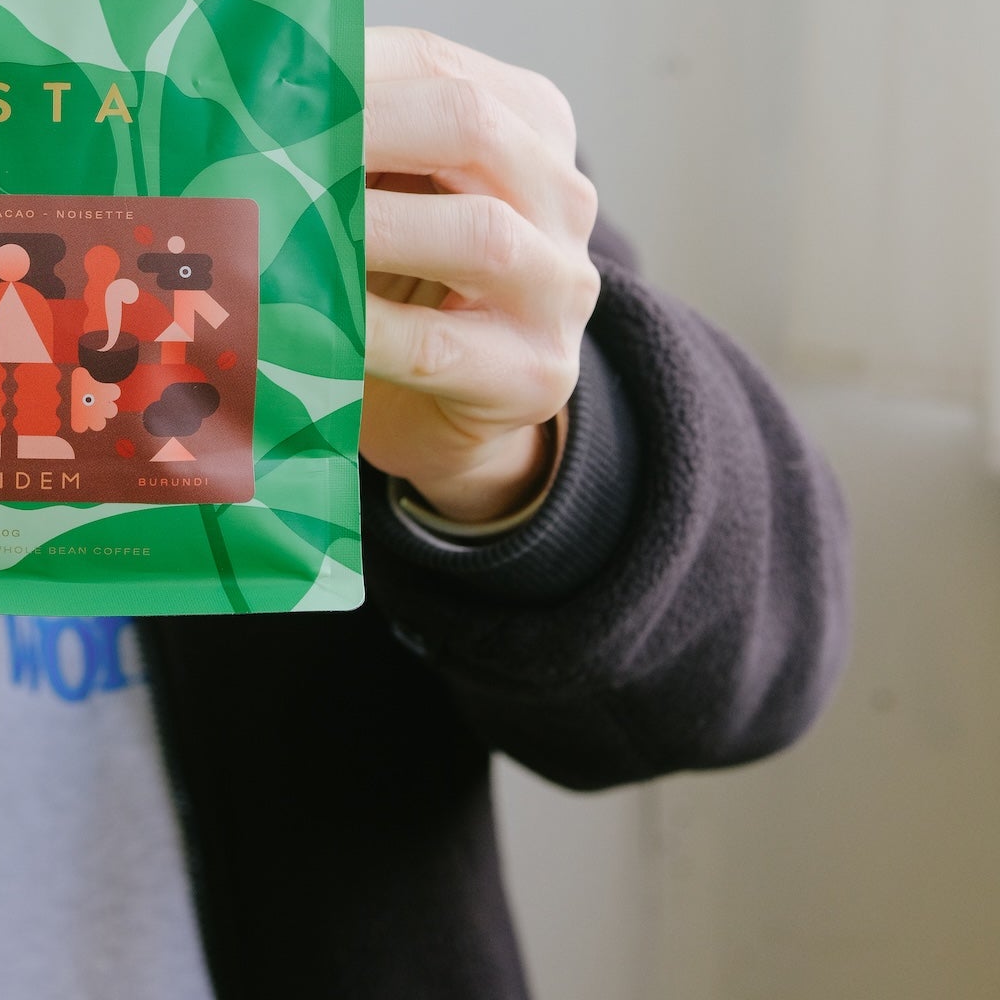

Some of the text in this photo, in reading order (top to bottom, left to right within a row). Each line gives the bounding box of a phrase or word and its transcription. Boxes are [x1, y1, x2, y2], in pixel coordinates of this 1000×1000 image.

[56, 209, 134, 220] NOISETTE
[138, 477, 208, 487] BURUNDI
[48, 546, 87, 555] BEAN
[93, 547, 150, 556] COFFEE
